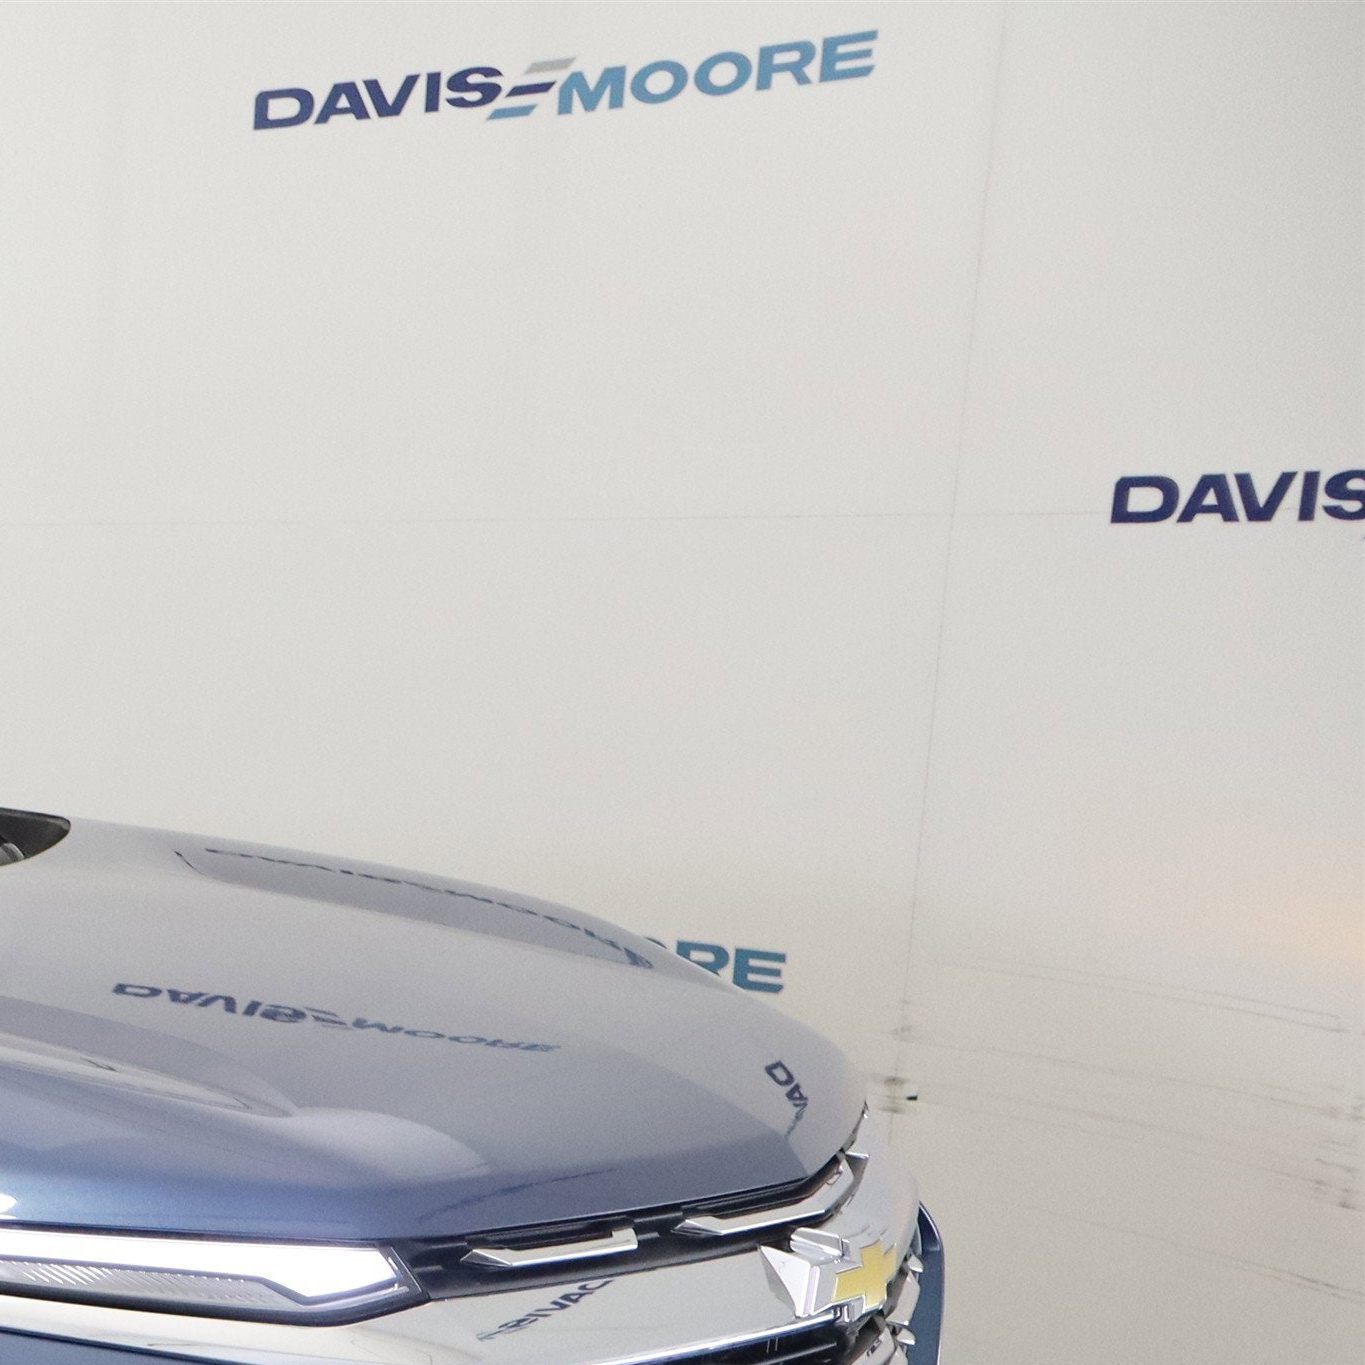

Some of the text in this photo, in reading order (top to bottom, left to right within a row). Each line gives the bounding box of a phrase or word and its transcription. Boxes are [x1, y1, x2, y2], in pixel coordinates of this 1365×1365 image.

[253, 30, 878, 130] DAVIS MOORE
[1110, 469, 1365, 523] DAVIS
